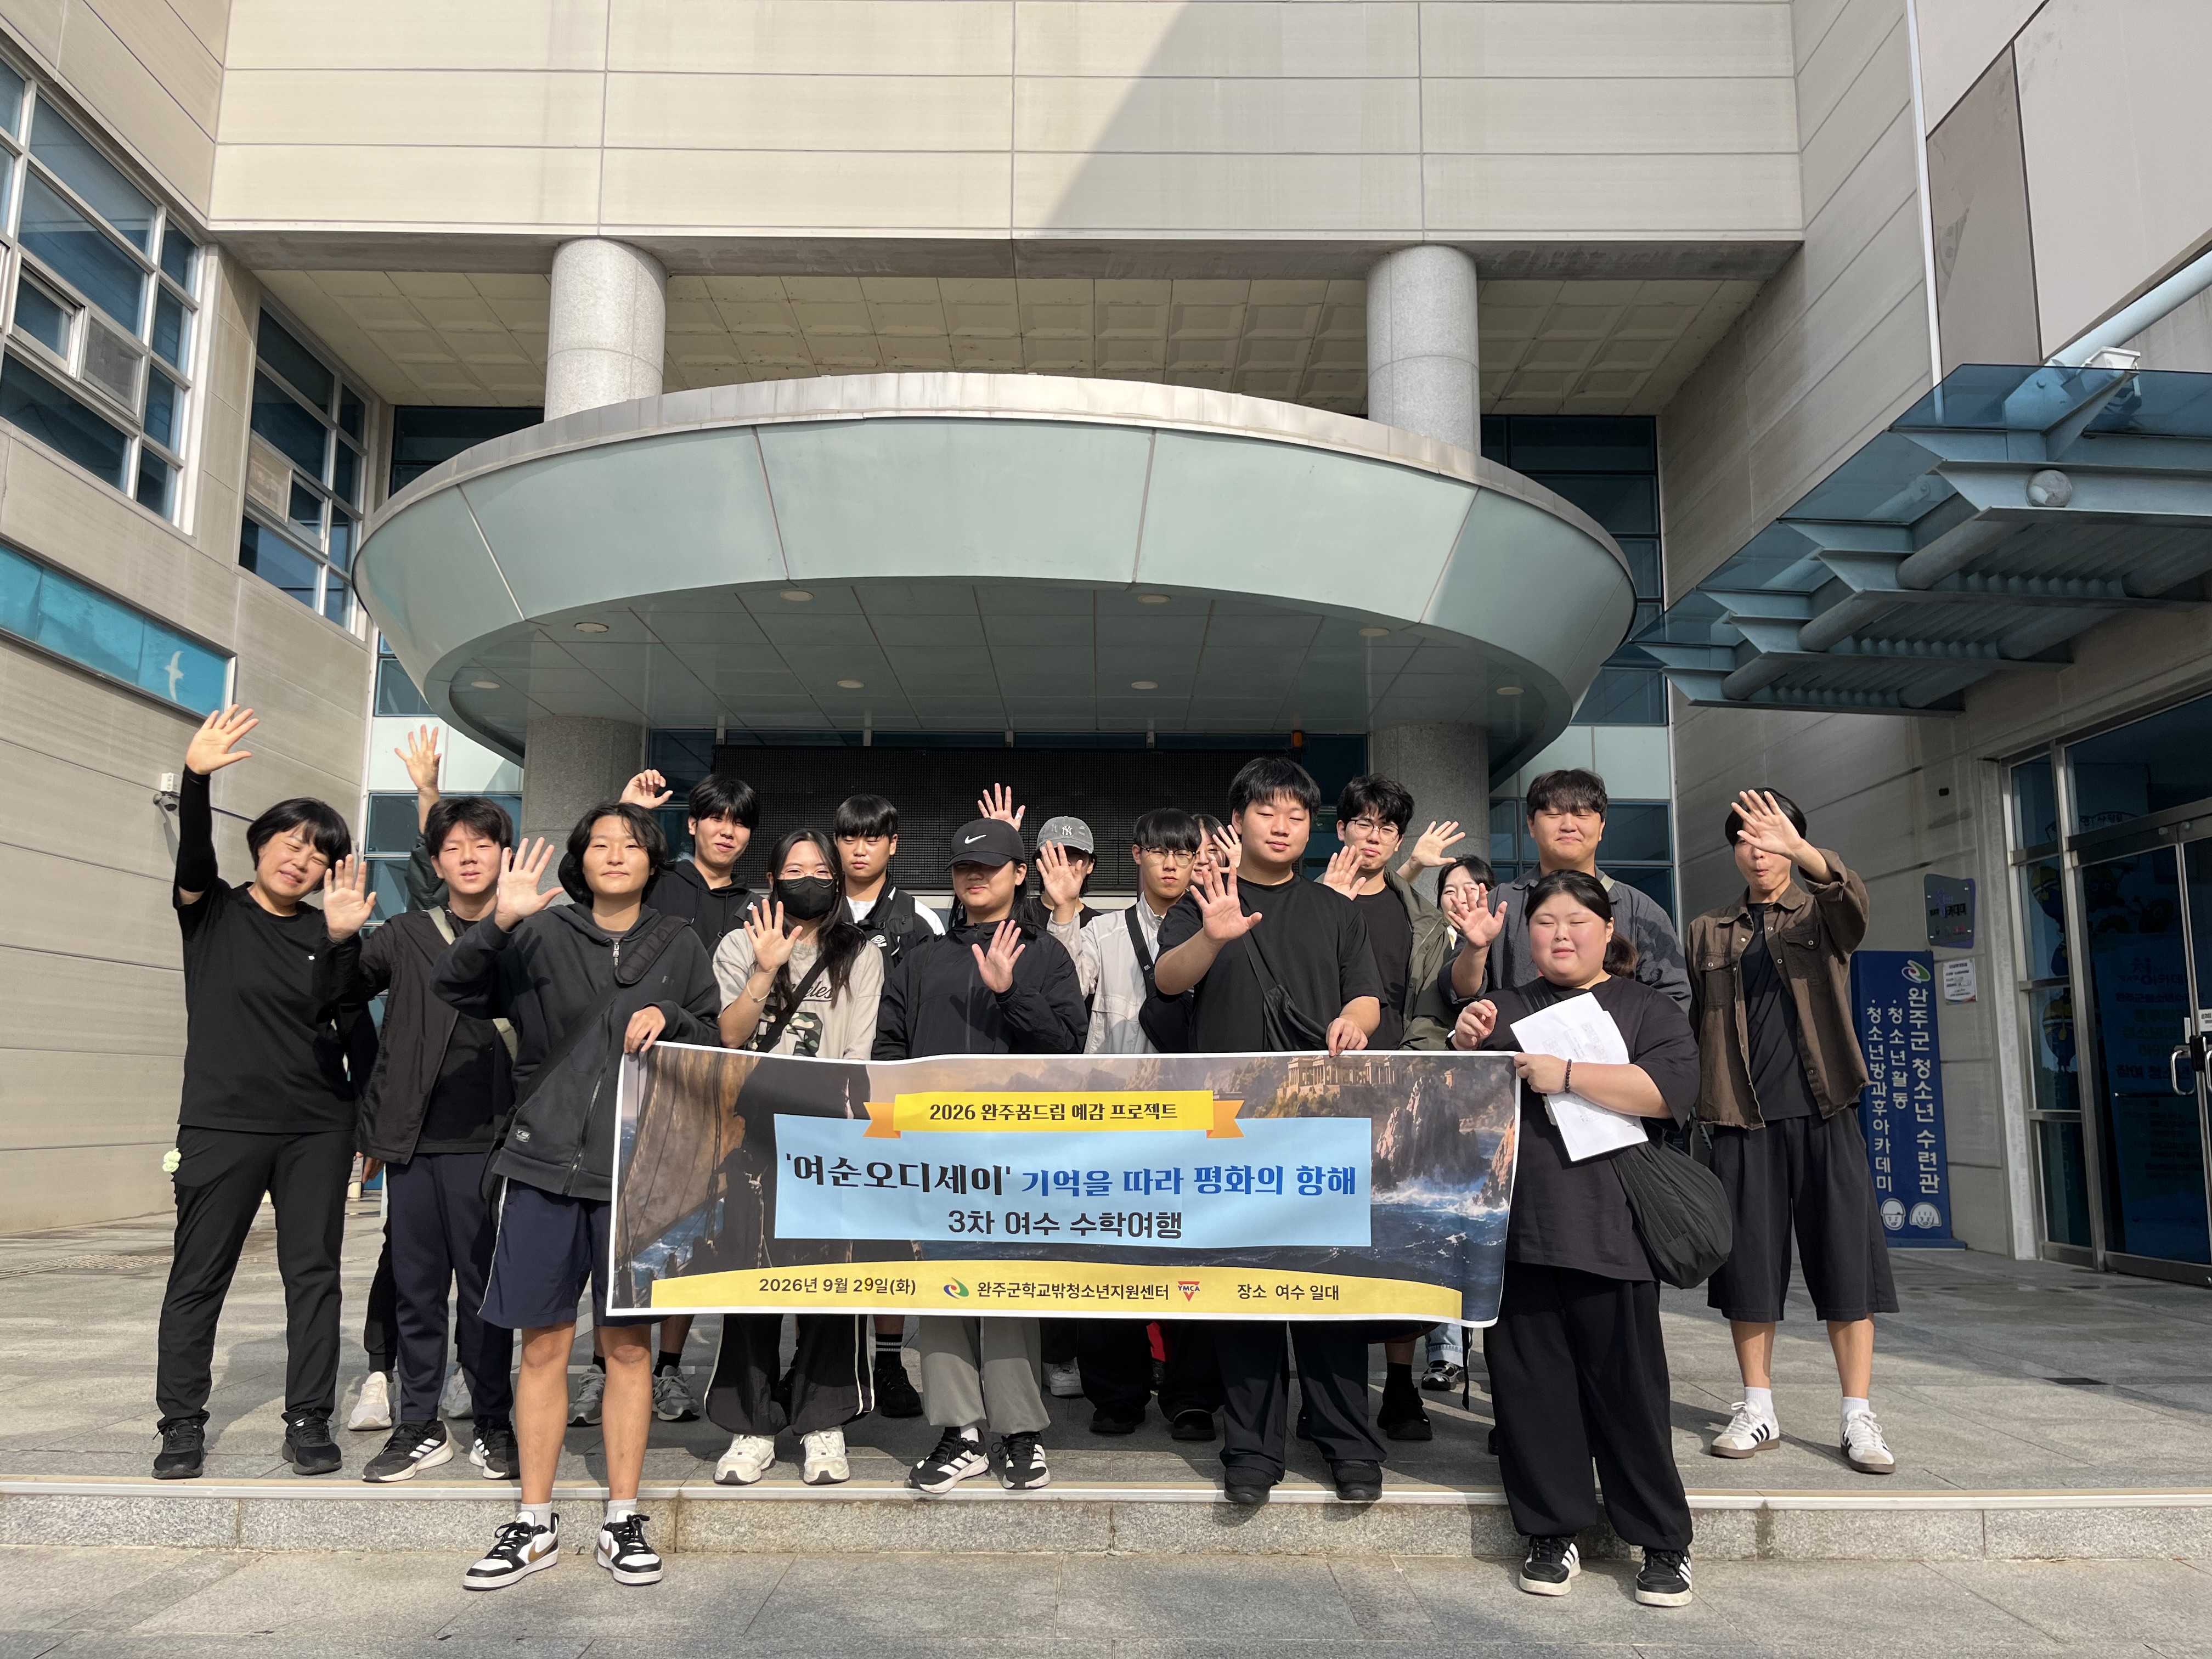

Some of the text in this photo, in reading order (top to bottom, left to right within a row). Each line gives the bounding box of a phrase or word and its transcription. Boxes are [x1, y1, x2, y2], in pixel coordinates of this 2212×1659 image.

[1062, 826, 1073, 836] NY
[1908, 988, 1940, 1194] 완주군 청소년 수련관
[929, 1103, 1178, 1121] 2026 완주꿈드림 예감 프로젝트
[786, 1153, 1356, 1197] '여순오디세이' 기억을 따라 평화의 항해
[948, 1210, 1182, 1239] 3차 여수 수학여행
[759, 1277, 917, 1296] 2026년 9월 29일(화)
[977, 1281, 1169, 1300] 완주군학교밖청소년지원센터
[1237, 1283, 1339, 1301] 장소 여수 일대
